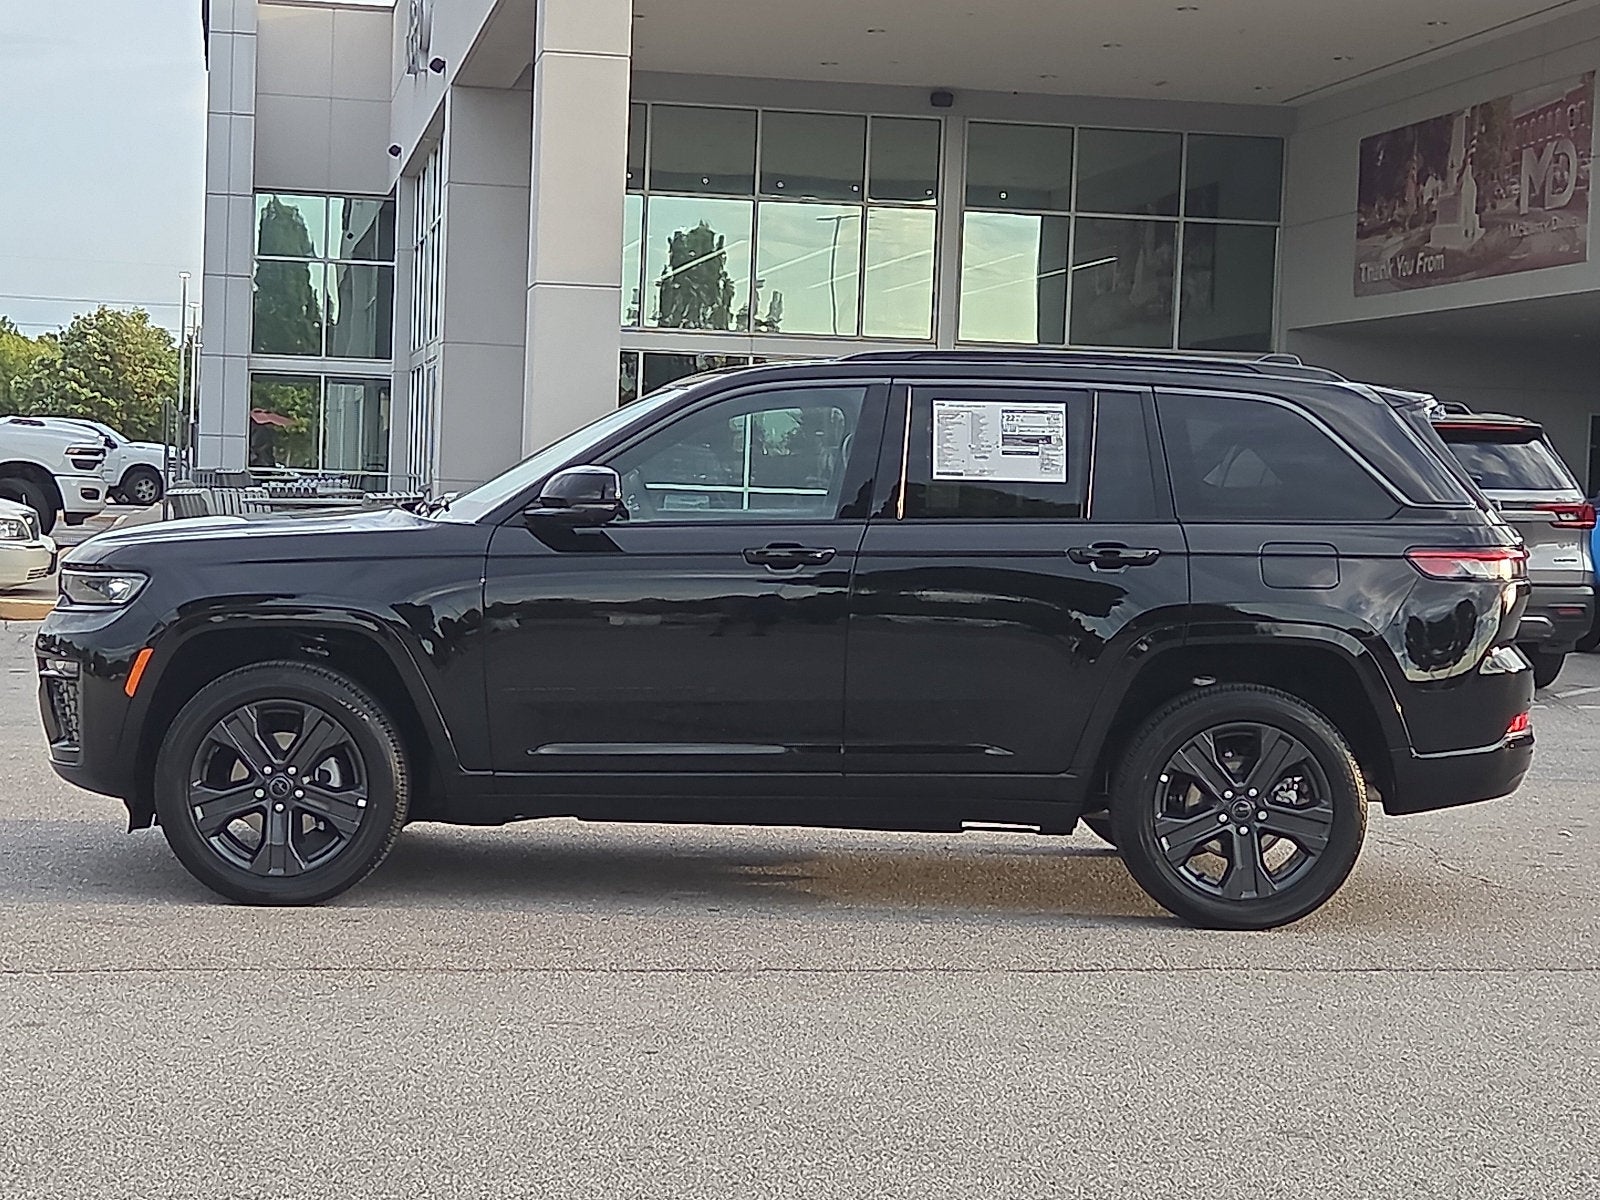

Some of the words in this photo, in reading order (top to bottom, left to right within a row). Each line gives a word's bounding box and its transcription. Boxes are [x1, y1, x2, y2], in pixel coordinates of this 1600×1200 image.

[1359, 258, 1393, 283] Thank
[1396, 255, 1415, 277] You
[1416, 252, 1445, 274] From
